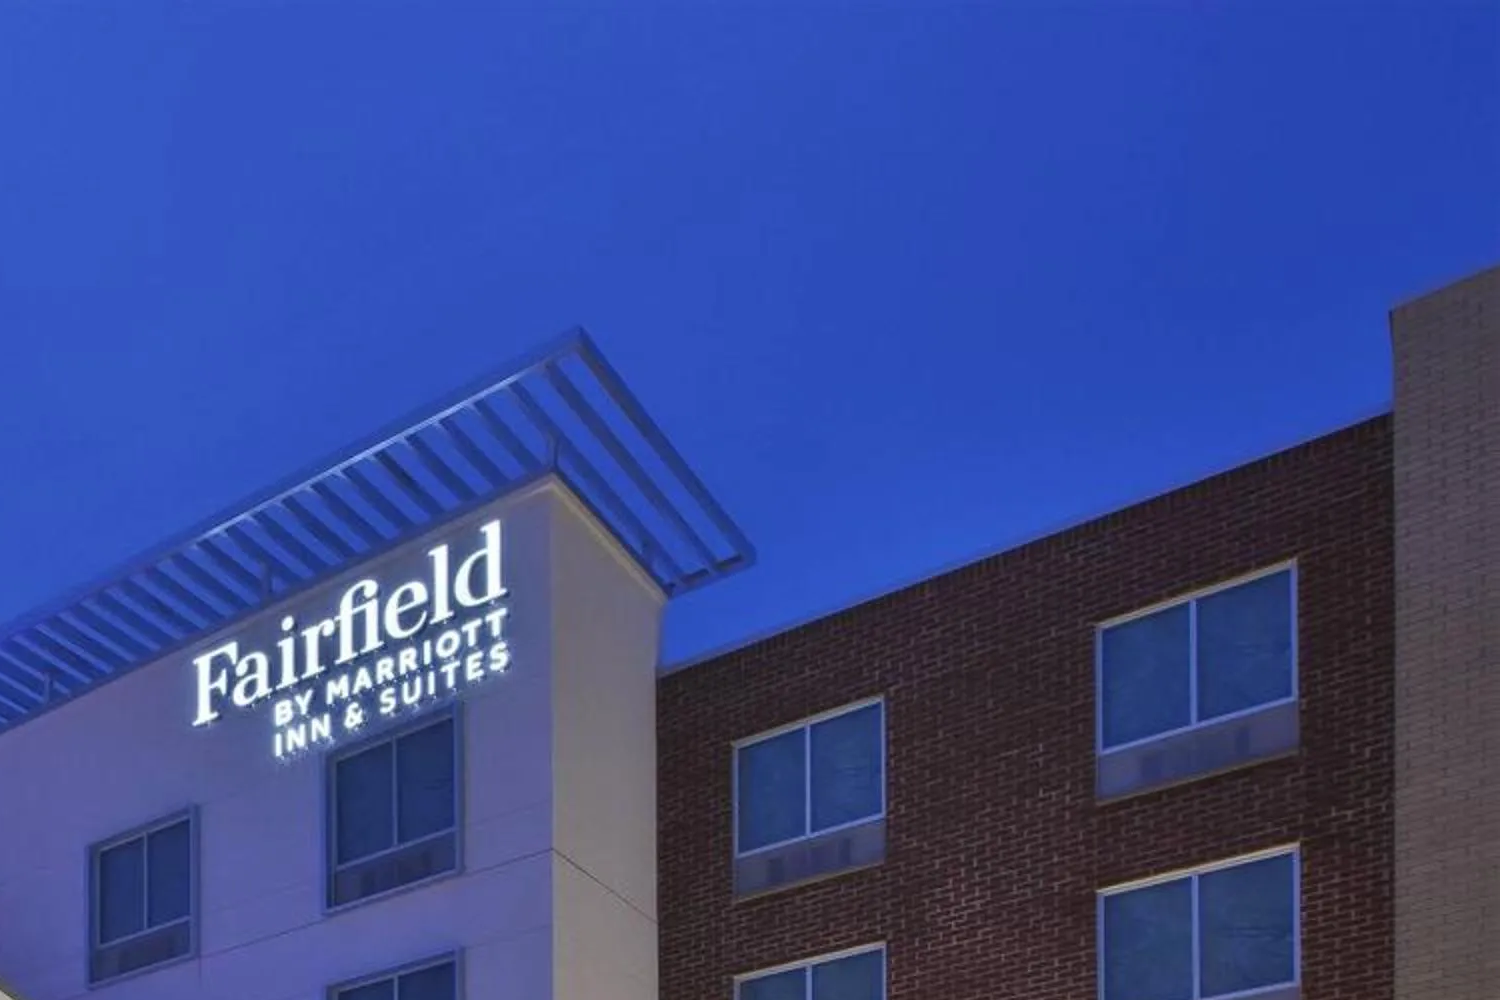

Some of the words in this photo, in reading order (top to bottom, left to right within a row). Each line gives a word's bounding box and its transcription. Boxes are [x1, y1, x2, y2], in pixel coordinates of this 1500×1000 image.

[192, 519, 507, 727] Fairfield
[274, 690, 314, 727] BY
[327, 608, 507, 704] MARRIOTT
[275, 714, 332, 758] INN
[344, 702, 364, 729] &
[379, 642, 510, 714] SUITES
